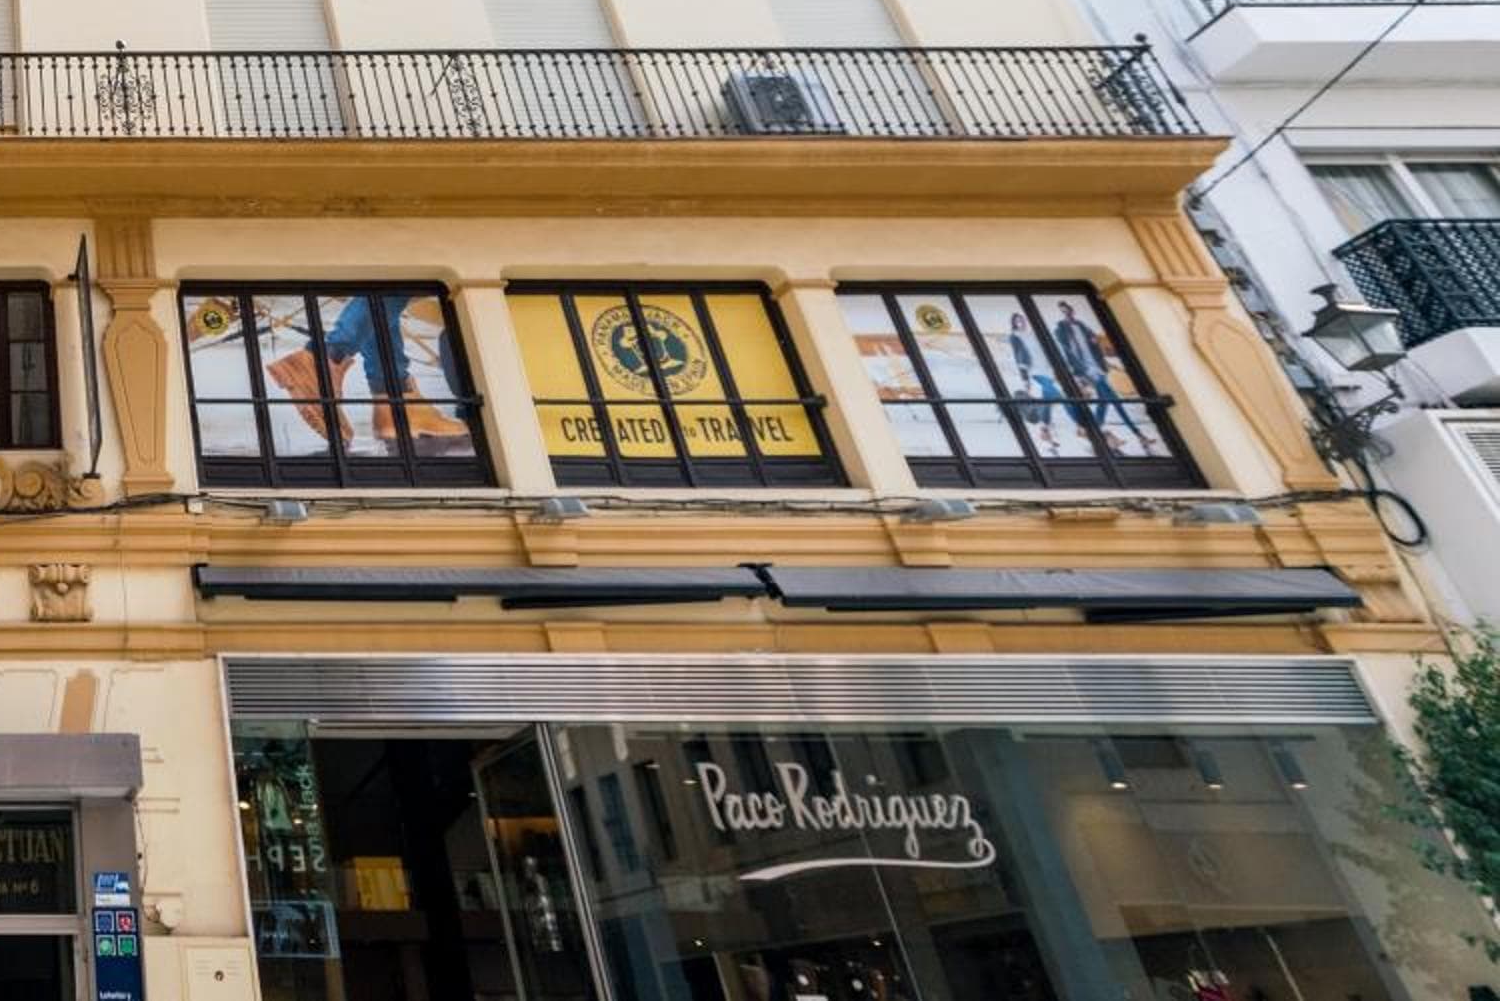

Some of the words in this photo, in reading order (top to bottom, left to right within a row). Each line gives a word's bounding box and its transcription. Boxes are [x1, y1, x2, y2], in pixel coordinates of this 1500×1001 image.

[561, 417, 665, 443] CREATED
[697, 417, 793, 442] TRAVEL
[696, 762, 787, 831] Paco
[775, 762, 996, 859] Rodriguez
